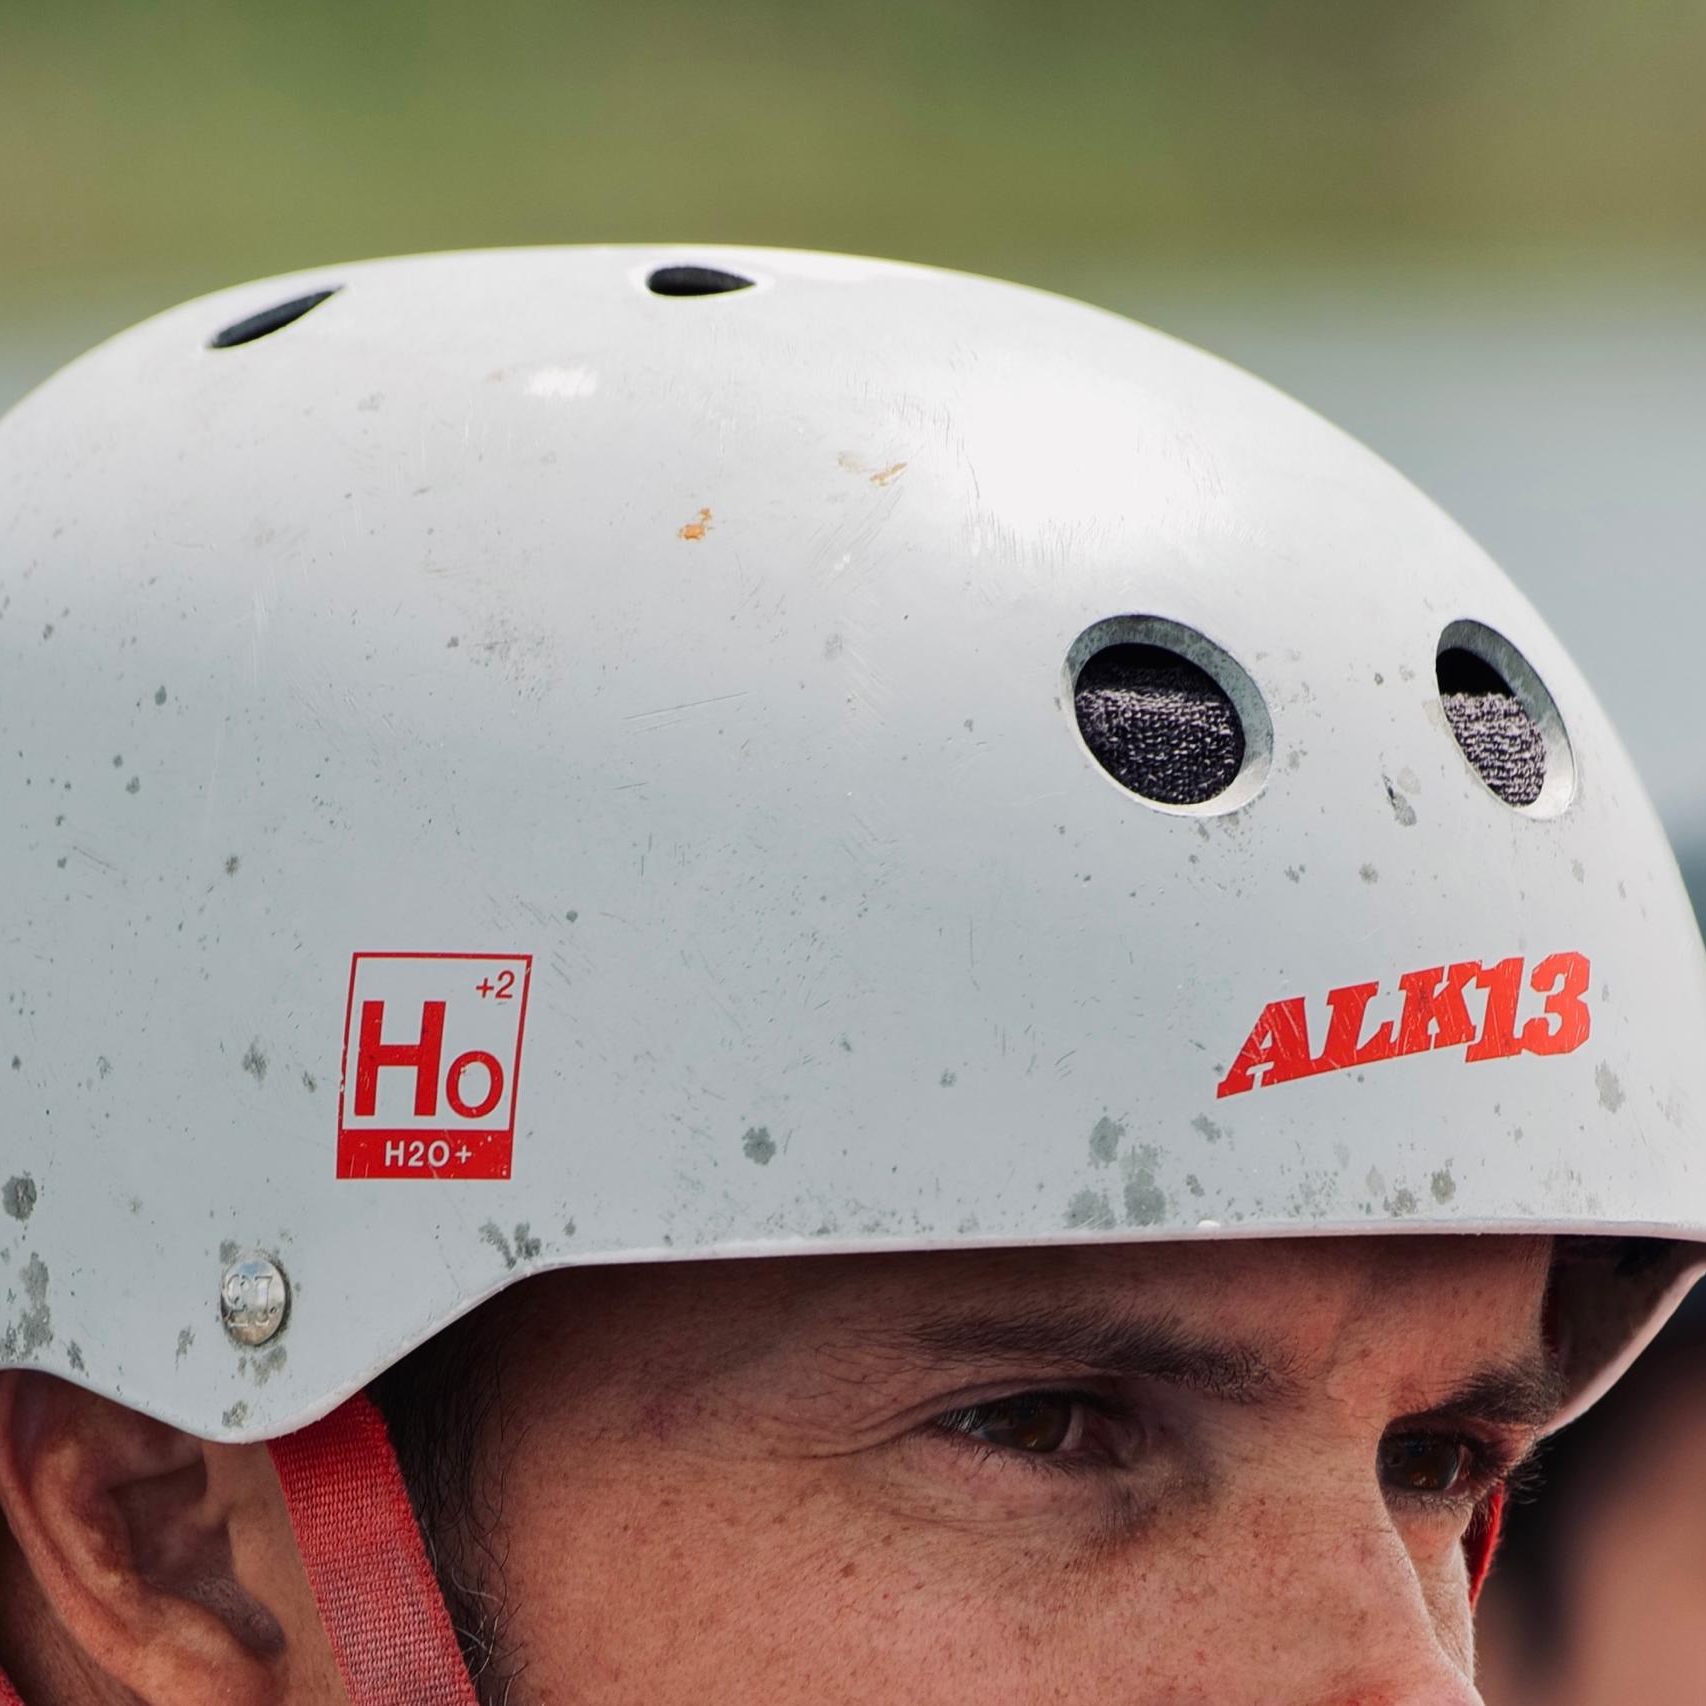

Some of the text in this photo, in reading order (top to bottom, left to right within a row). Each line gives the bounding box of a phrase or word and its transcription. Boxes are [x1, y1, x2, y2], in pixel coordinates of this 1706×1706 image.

[475, 970, 515, 999] +2
[1216, 951, 1591, 1099] ALK13
[354, 1000, 505, 1119] Ho
